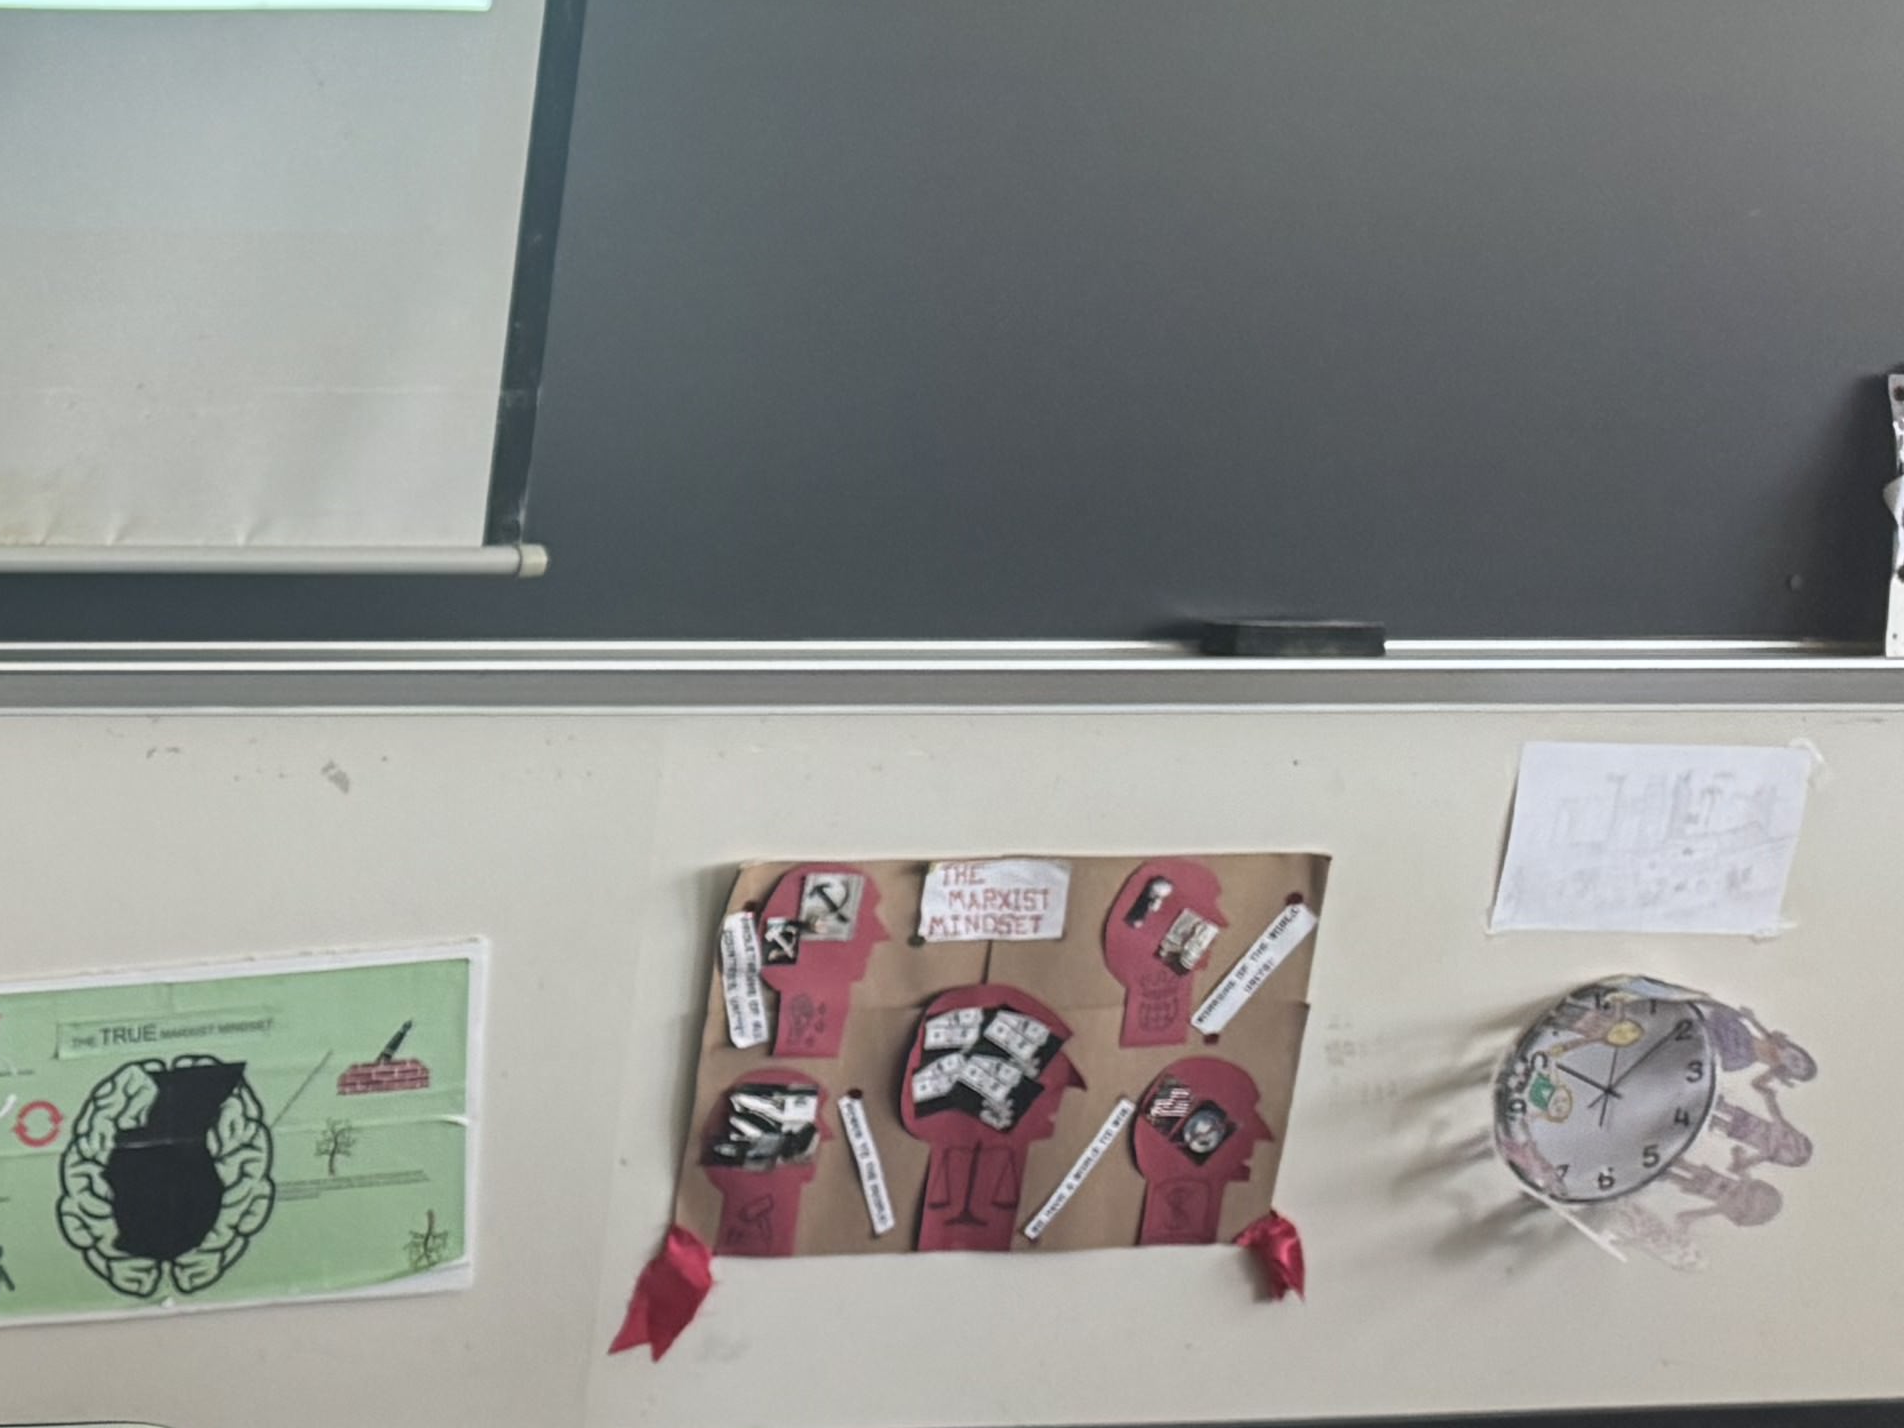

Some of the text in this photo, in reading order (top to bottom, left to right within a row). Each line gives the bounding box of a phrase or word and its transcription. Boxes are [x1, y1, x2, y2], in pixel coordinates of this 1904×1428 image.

[942, 863, 985, 887] THE
[949, 888, 1050, 912] MARXIST
[929, 913, 1044, 936] MINDSET
[99, 1023, 158, 1046] TRUE
